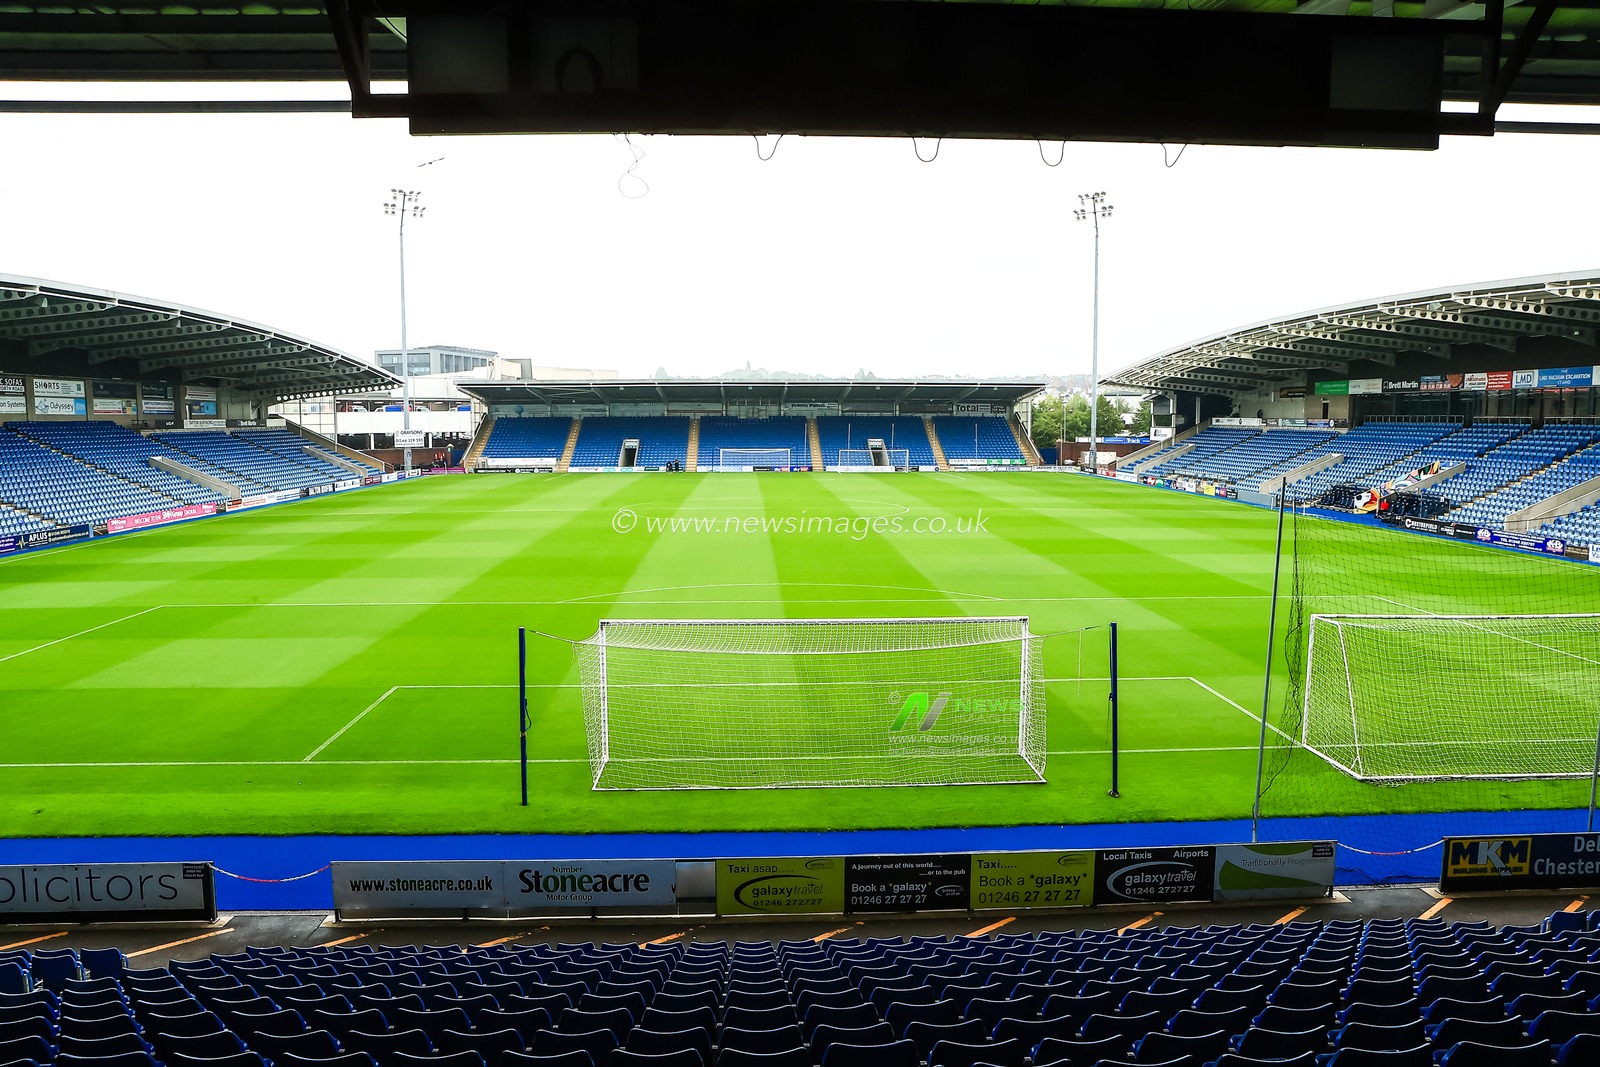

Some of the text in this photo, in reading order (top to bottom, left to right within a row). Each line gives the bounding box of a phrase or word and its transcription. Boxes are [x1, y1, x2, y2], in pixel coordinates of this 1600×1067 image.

[4, 378, 23, 386] SOFAS
[1515, 374, 1532, 384] LMD
[34, 381, 60, 390] SHORTS
[1388, 381, 1401, 389] Brett
[1402, 380, 1419, 389] Martin
[7, 401, 26, 409] Systems
[49, 401, 74, 412] Odyssey
[956, 404, 979, 412] Total
[28, 531, 48, 542] APLUS
[1103, 849, 1209, 861] Local Taxis Airports
[1450, 840, 1529, 875] MKM
[857, 863, 882, 871] journey
[1241, 858, 1286, 867] Traditionally
[1533, 858, 1600, 876] Chester
[552, 865, 583, 874] Number
[727, 864, 750, 874] Taxi
[0, 867, 178, 903] olicitors
[350, 876, 493, 892] www.stoneacre.co.uk
[518, 869, 650, 894] Stoneacre
[979, 874, 1013, 887] Book
[1017, 876, 1025, 886] a
[851, 883, 877, 893] Book
[879, 884, 886, 892] a
[1125, 885, 1195, 895] 01246 272727
[546, 893, 593, 902] Motor Group
[851, 894, 927, 905] 01246 27 27 27
[978, 889, 1081, 904] 01246 27 27 27
[752, 898, 822, 907] 01246 272727
